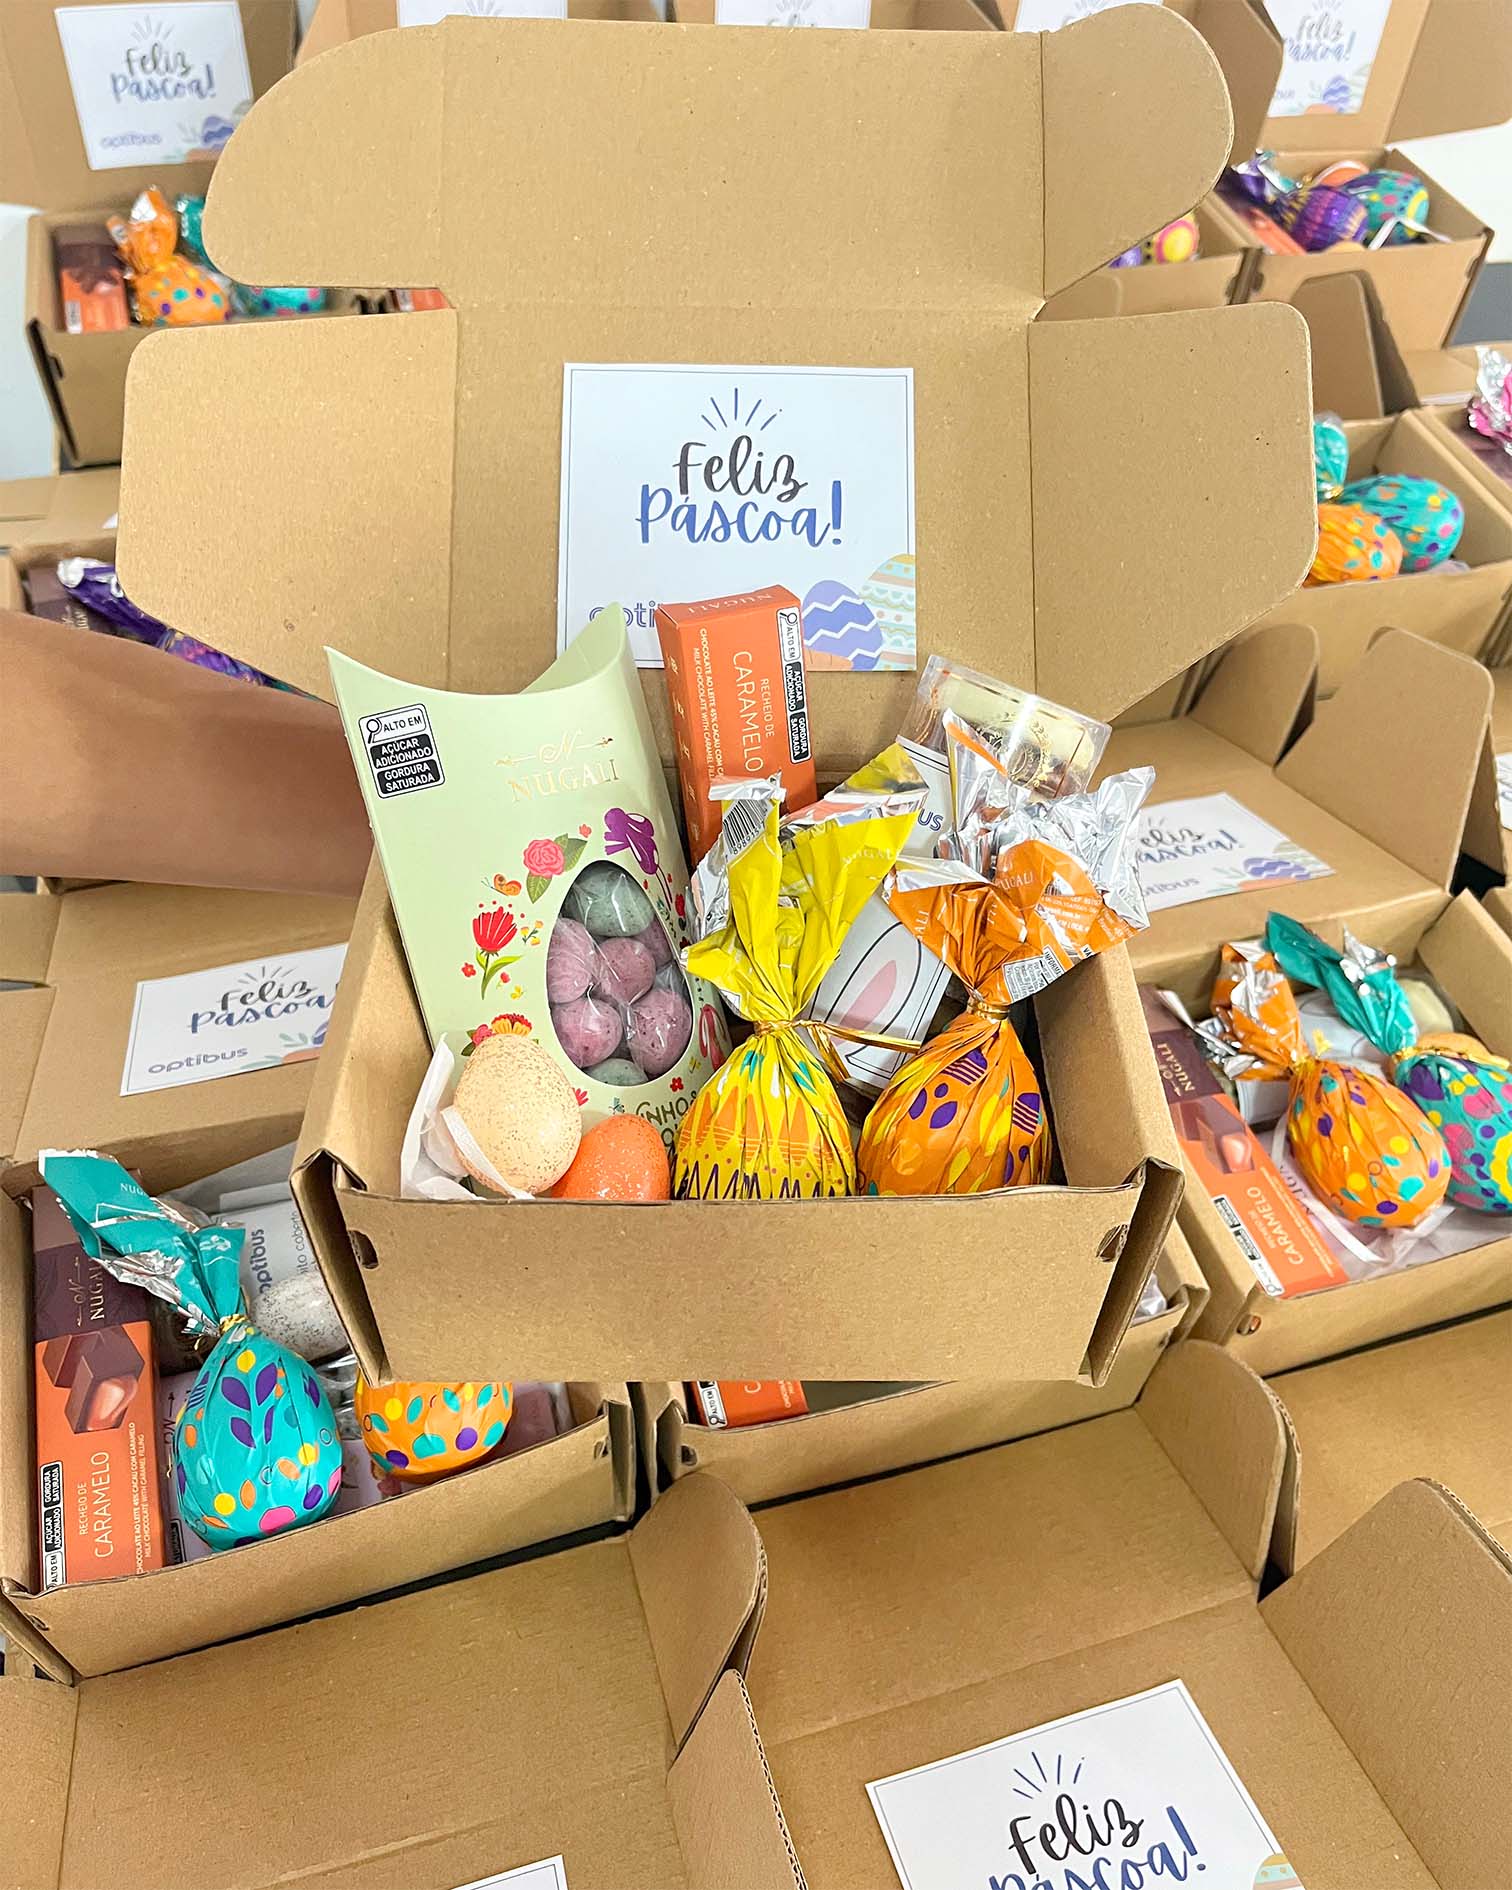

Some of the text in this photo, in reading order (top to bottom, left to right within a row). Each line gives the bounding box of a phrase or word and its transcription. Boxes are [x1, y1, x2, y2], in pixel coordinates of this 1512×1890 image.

[122, 42, 192, 78] Feliz
[672, 435, 808, 503] Feliz
[635, 480, 842, 548] Páscoa!
[700, 628, 712, 673] CHOCOLATE
[786, 627, 796, 658] ALTO EM
[706, 676, 713, 687] AO
[708, 688, 716, 706] LEITE
[785, 665, 796, 711] ADICIONADO
[384, 715, 423, 733] ALTO EM
[695, 666, 707, 711] CHOCOLATE
[703, 732, 713, 764] CARAMEL
[733, 651, 764, 772] CARAMELO
[760, 678, 775, 738] RECHEIO DE
[381, 737, 420, 756] AÇÚCAR
[712, 723, 721, 748] CACAU
[790, 718, 800, 757] SATURADA
[798, 717, 808, 753] GORDURA
[375, 746, 431, 768] ADICIONADO
[384, 762, 431, 781] GORDURA
[385, 772, 436, 792] SATURADA
[506, 759, 619, 803] NUGALI
[1140, 828, 1205, 849] eliz
[217, 980, 318, 1011] Feliz
[148, 1048, 248, 1074] optibus
[1157, 1043, 1195, 1092] NUGALI
[1247, 1187, 1305, 1265] CARAMELO
[128, 1423, 136, 1455] CARAMELO
[44, 1470, 52, 1502] GORDURA
[77, 1482, 89, 1535] RECHEIO DE
[91, 1452, 114, 1558] CARAMELO
[49, 1555, 58, 1583] ALTO EM
[1008, 1793, 1144, 1875] Feliz
